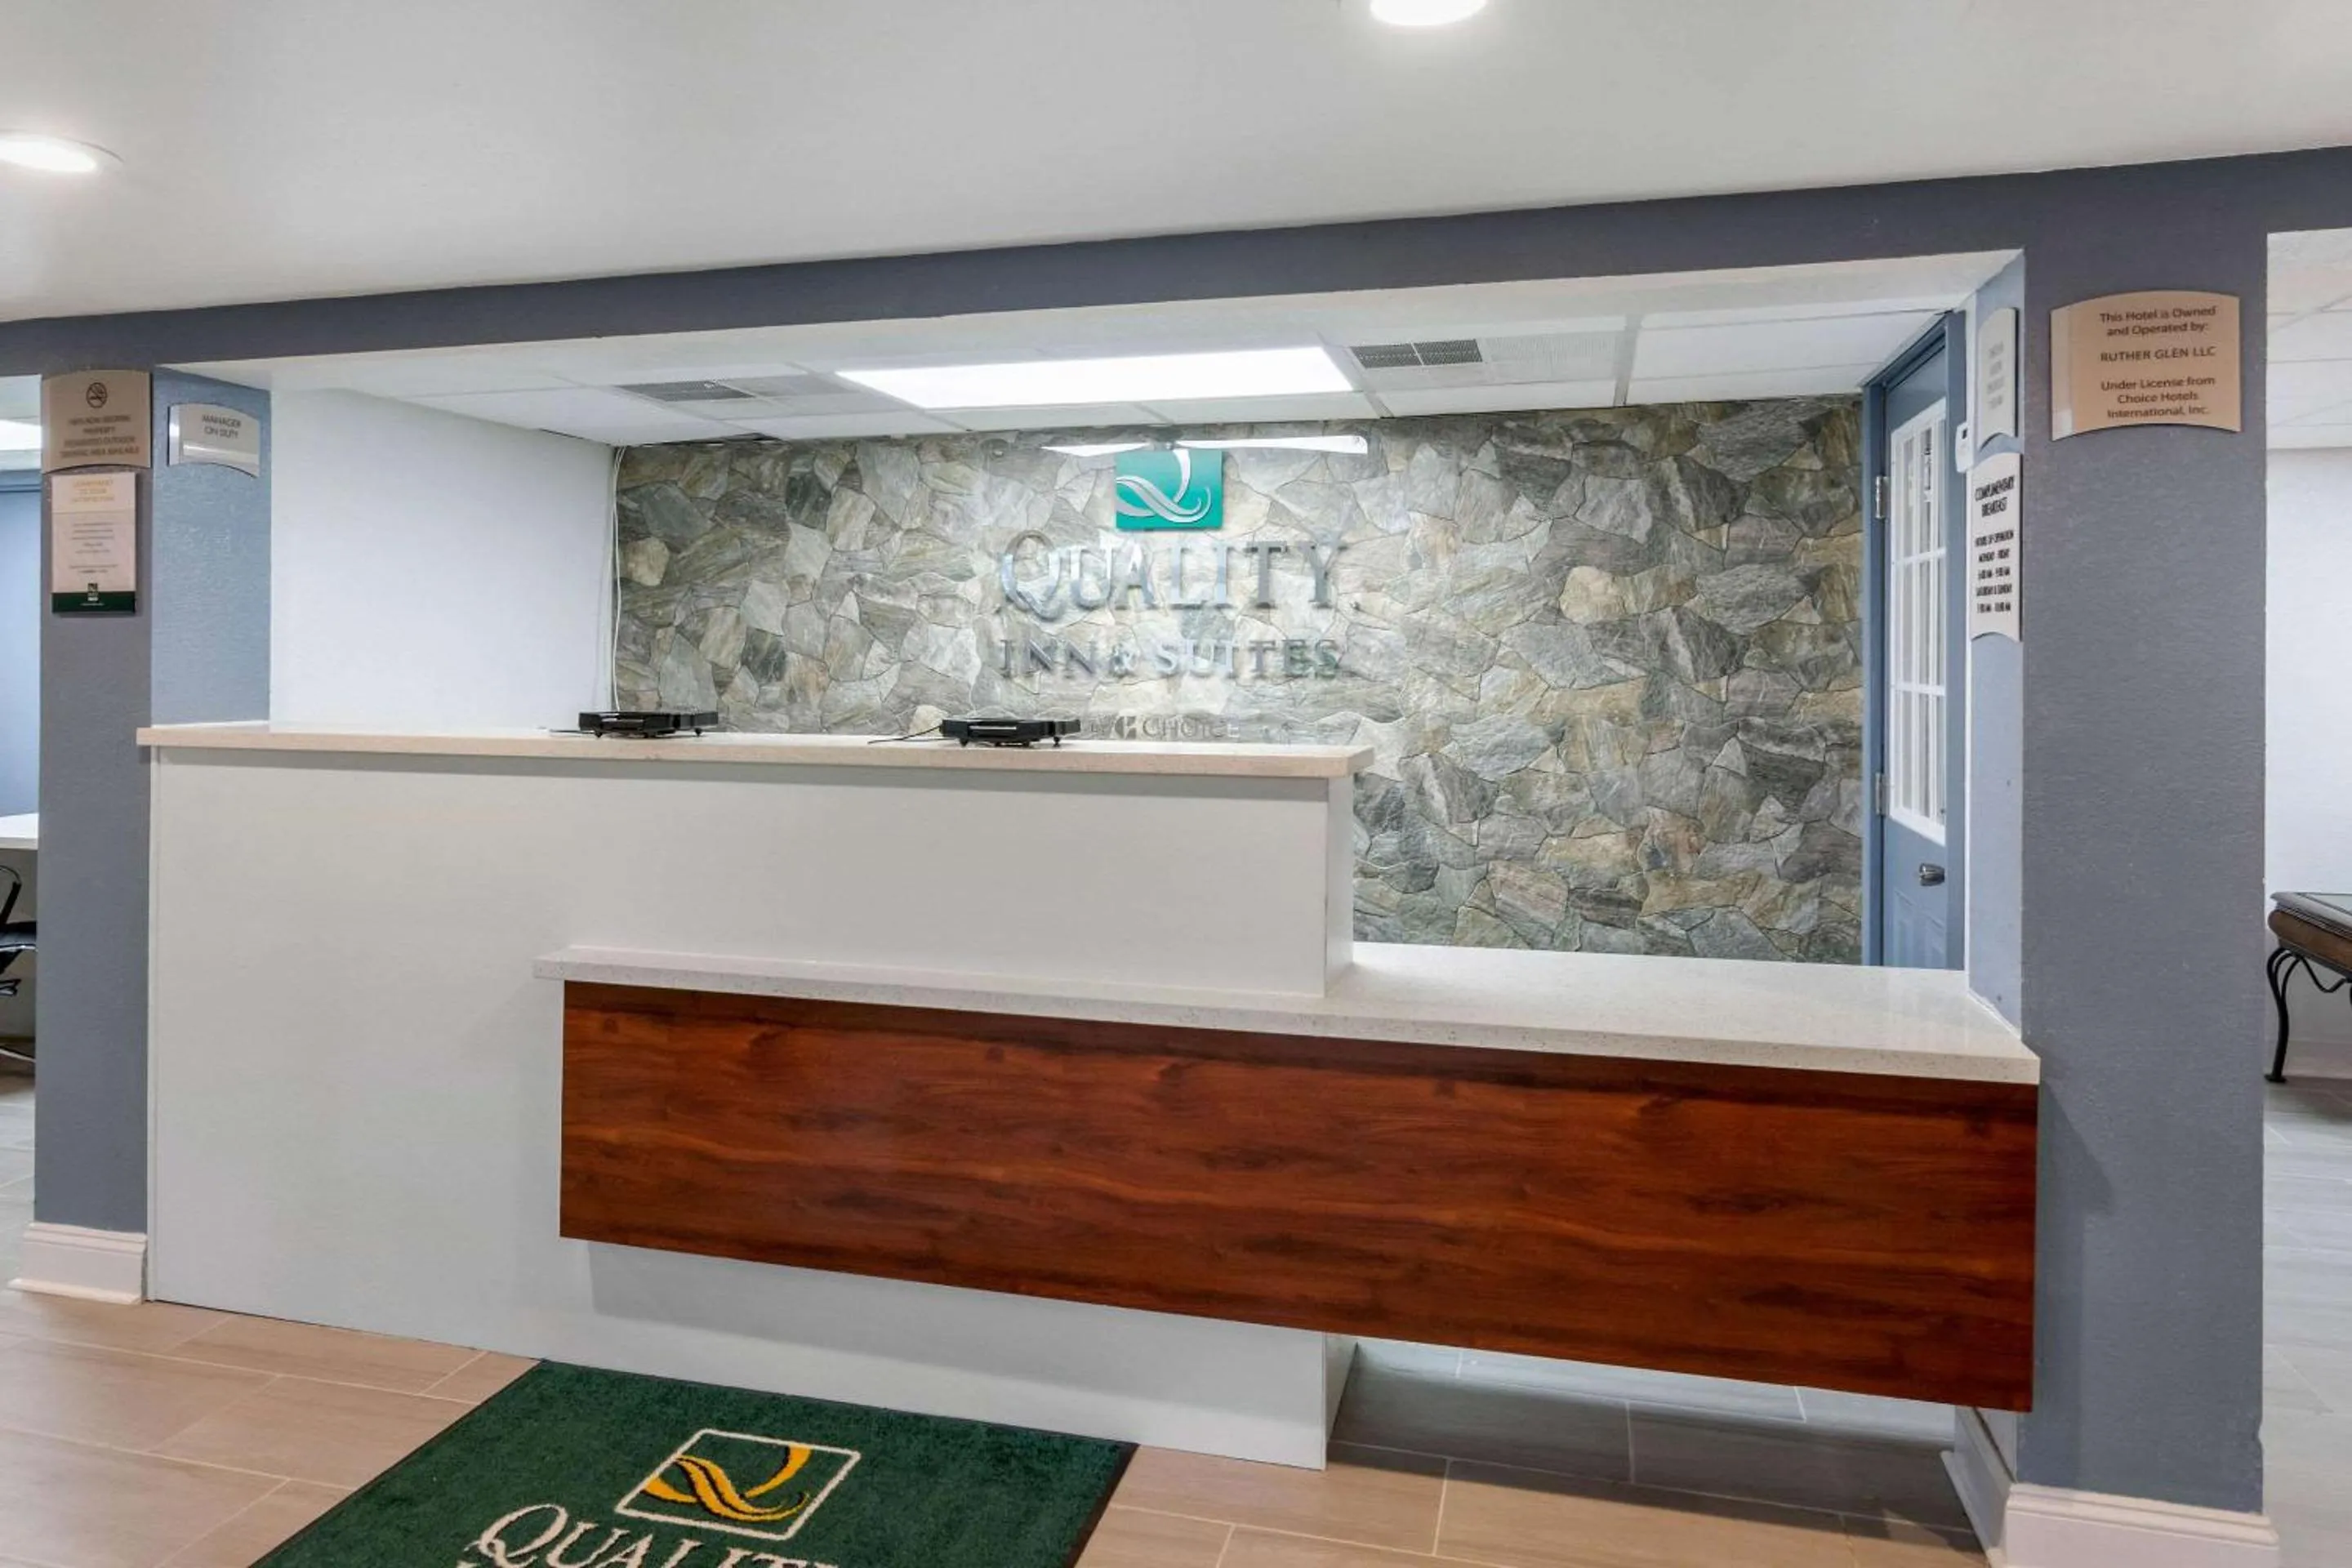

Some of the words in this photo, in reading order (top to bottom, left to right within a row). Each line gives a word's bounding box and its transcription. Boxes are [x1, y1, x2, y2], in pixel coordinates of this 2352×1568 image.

[2100, 312, 2123, 323] This
[2126, 308, 2158, 322] Hotel
[2160, 309, 2170, 319] is
[2172, 305, 2217, 318] Owned
[2107, 326, 2130, 337] and
[2132, 323, 2188, 336] Operated
[2190, 321, 2209, 333] by:
[2100, 350, 2151, 363] RUTHER
[2154, 347, 2189, 360] GLEN
[2193, 345, 2217, 358] LLC
[2100, 380, 2137, 391] Under
[2140, 377, 2185, 390] License
[2186, 376, 2216, 386] from
[2117, 393, 2158, 405] Choice
[2160, 390, 2199, 403] Hotels
[2188, 404, 2211, 415] Inc.
[999, 528, 1349, 623] QUALITY
[1000, 639, 1098, 679] INN
[1152, 639, 1340, 681] SUITES
[1143, 715, 1240, 738] CHOICE
[463, 1503, 840, 1568] QUAL
